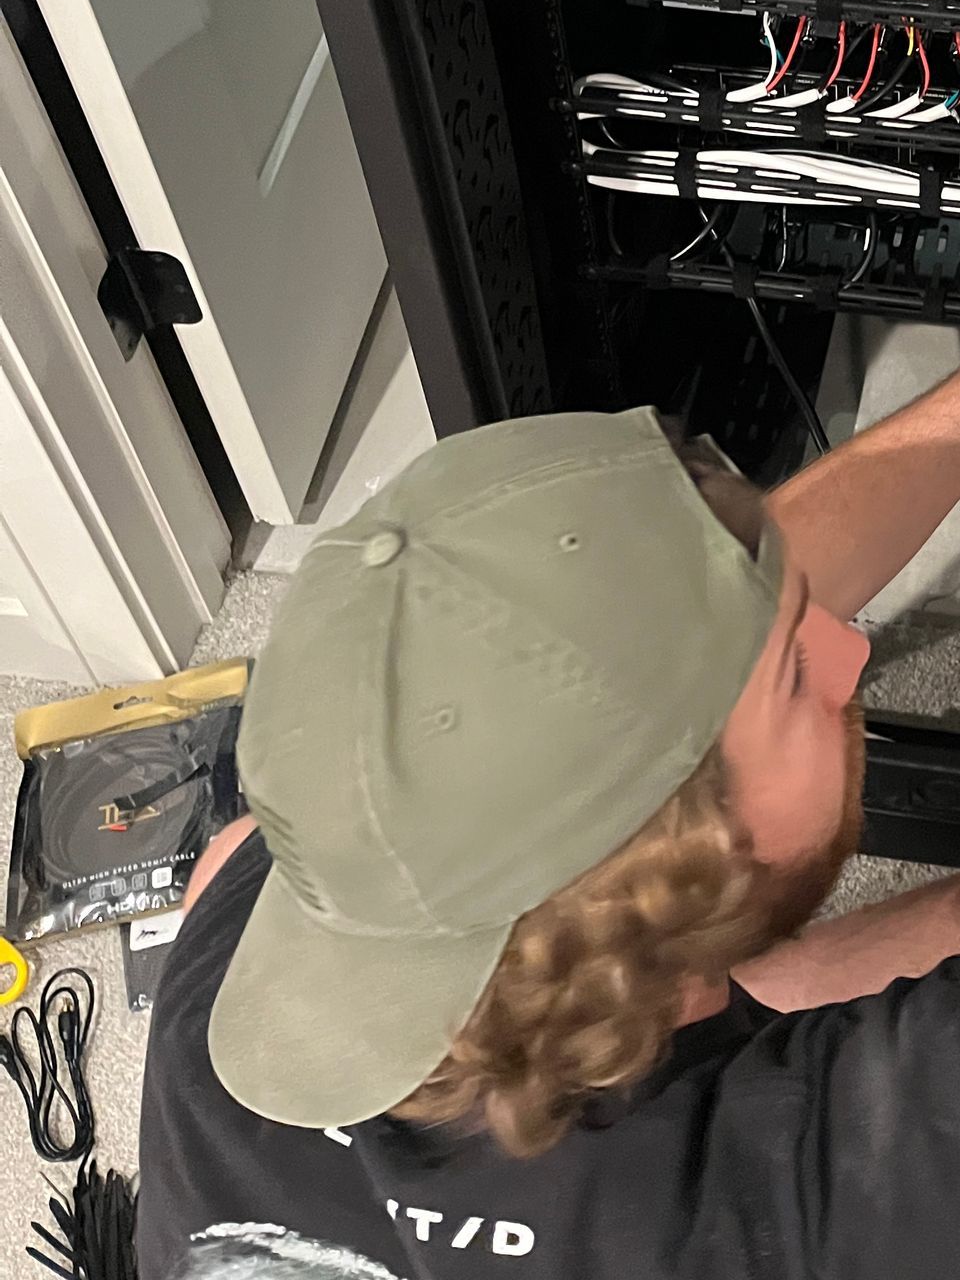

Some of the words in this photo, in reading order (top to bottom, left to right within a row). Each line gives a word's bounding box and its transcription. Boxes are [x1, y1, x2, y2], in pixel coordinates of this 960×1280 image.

[62, 876, 87, 890] ULTRA
[89, 869, 110, 881] HIGH
[112, 863, 138, 875] SPEED
[169, 851, 195, 863] CABLE
